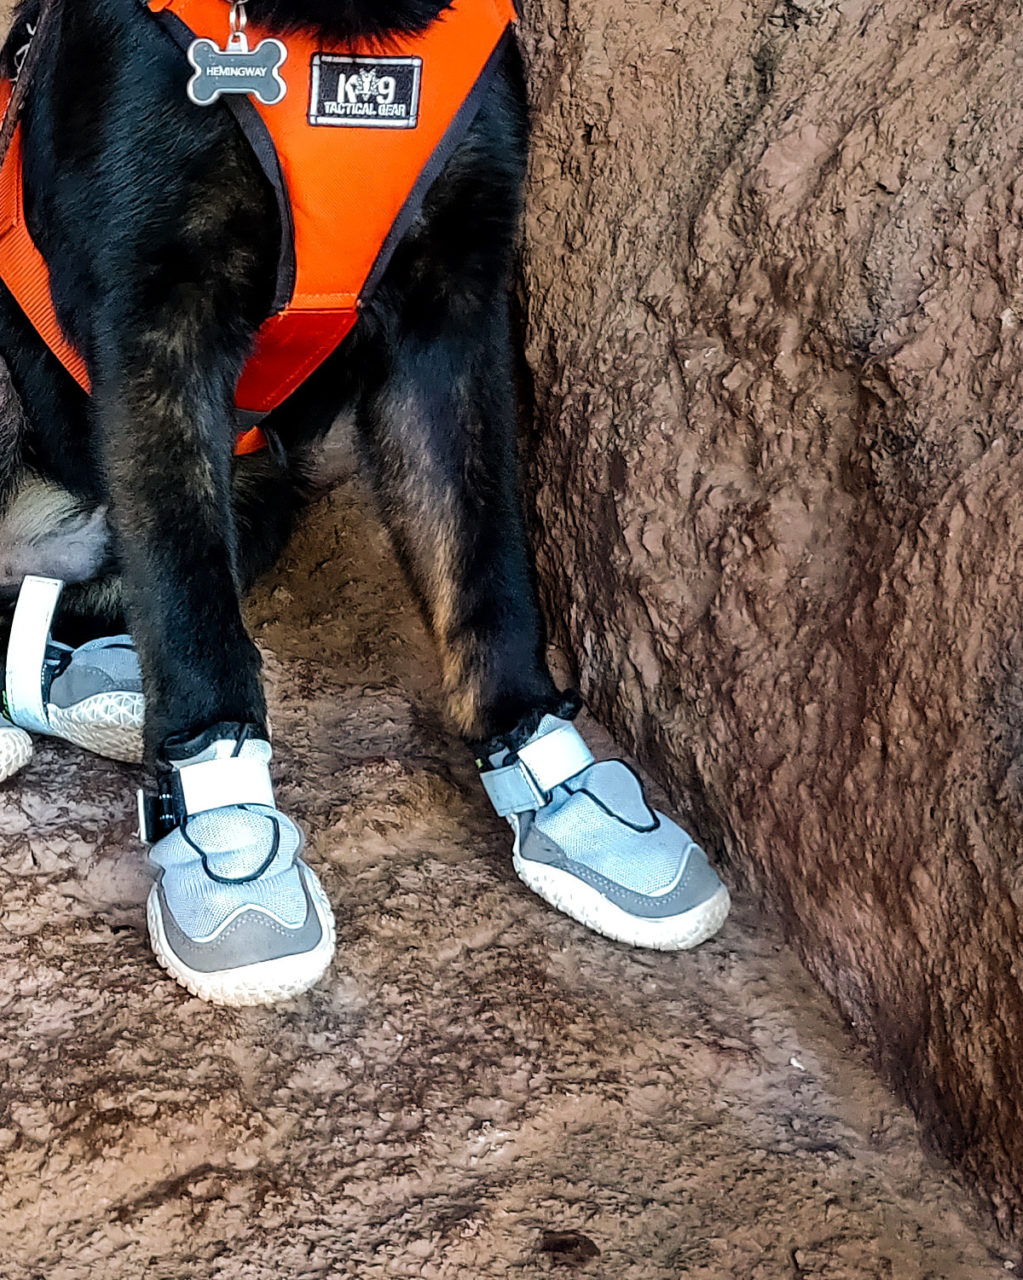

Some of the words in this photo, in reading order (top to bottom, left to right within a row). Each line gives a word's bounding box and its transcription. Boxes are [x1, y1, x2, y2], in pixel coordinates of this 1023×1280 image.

[206, 66, 267, 77] HEMINGWAY
[324, 102, 376, 116] TACTICAL
[378, 103, 406, 117] GEAR
